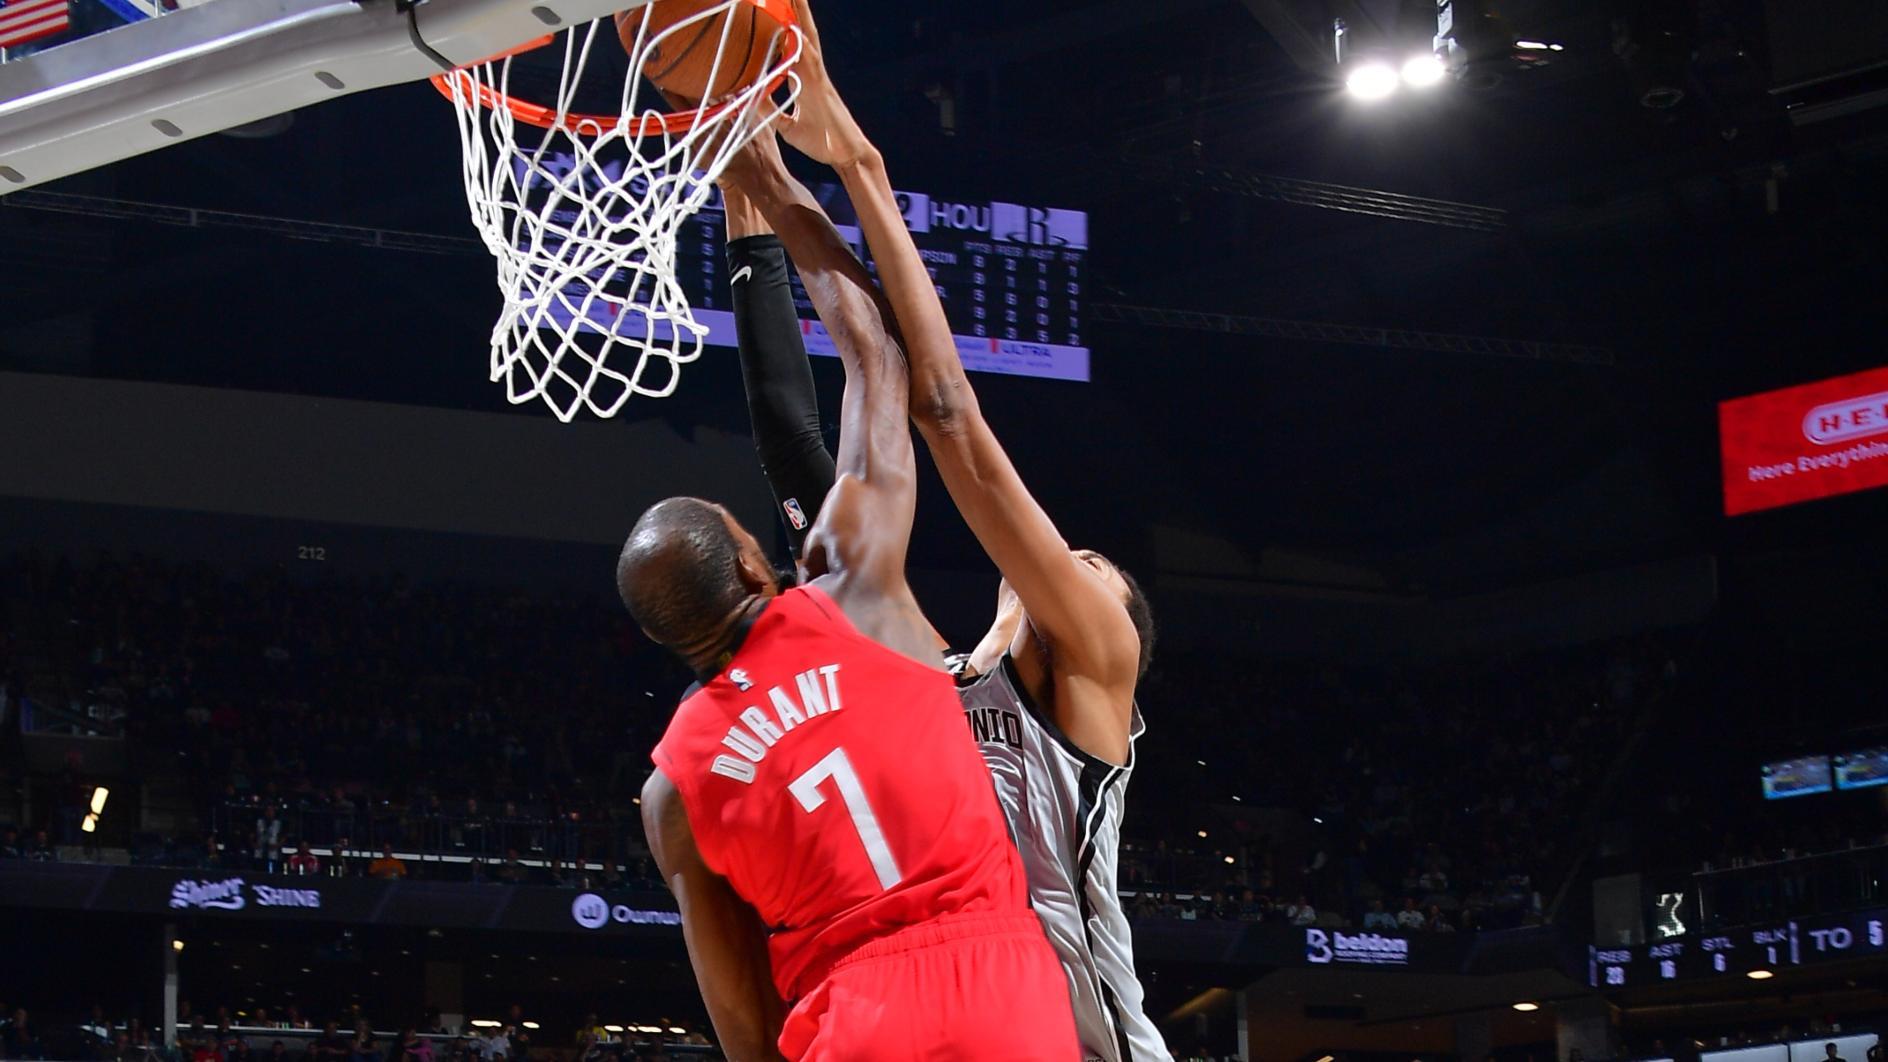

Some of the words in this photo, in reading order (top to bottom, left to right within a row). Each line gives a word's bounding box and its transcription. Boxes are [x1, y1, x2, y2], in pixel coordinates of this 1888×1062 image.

[930, 200, 991, 233] HOU
[1002, 343, 1053, 359] ULTRA
[1748, 462, 1796, 482] Here
[298, 546, 326, 561] 212
[711, 663, 843, 785] DURANT
[787, 746, 903, 891] 7
[1333, 931, 1409, 953] beldon
[1649, 942, 1685, 959] AST
[1701, 936, 1736, 951] STL
[1752, 928, 1788, 945] BLK
[1808, 926, 1852, 951] TO
[1867, 919, 1884, 947] 5
[1767, 946, 1777, 965] 1
